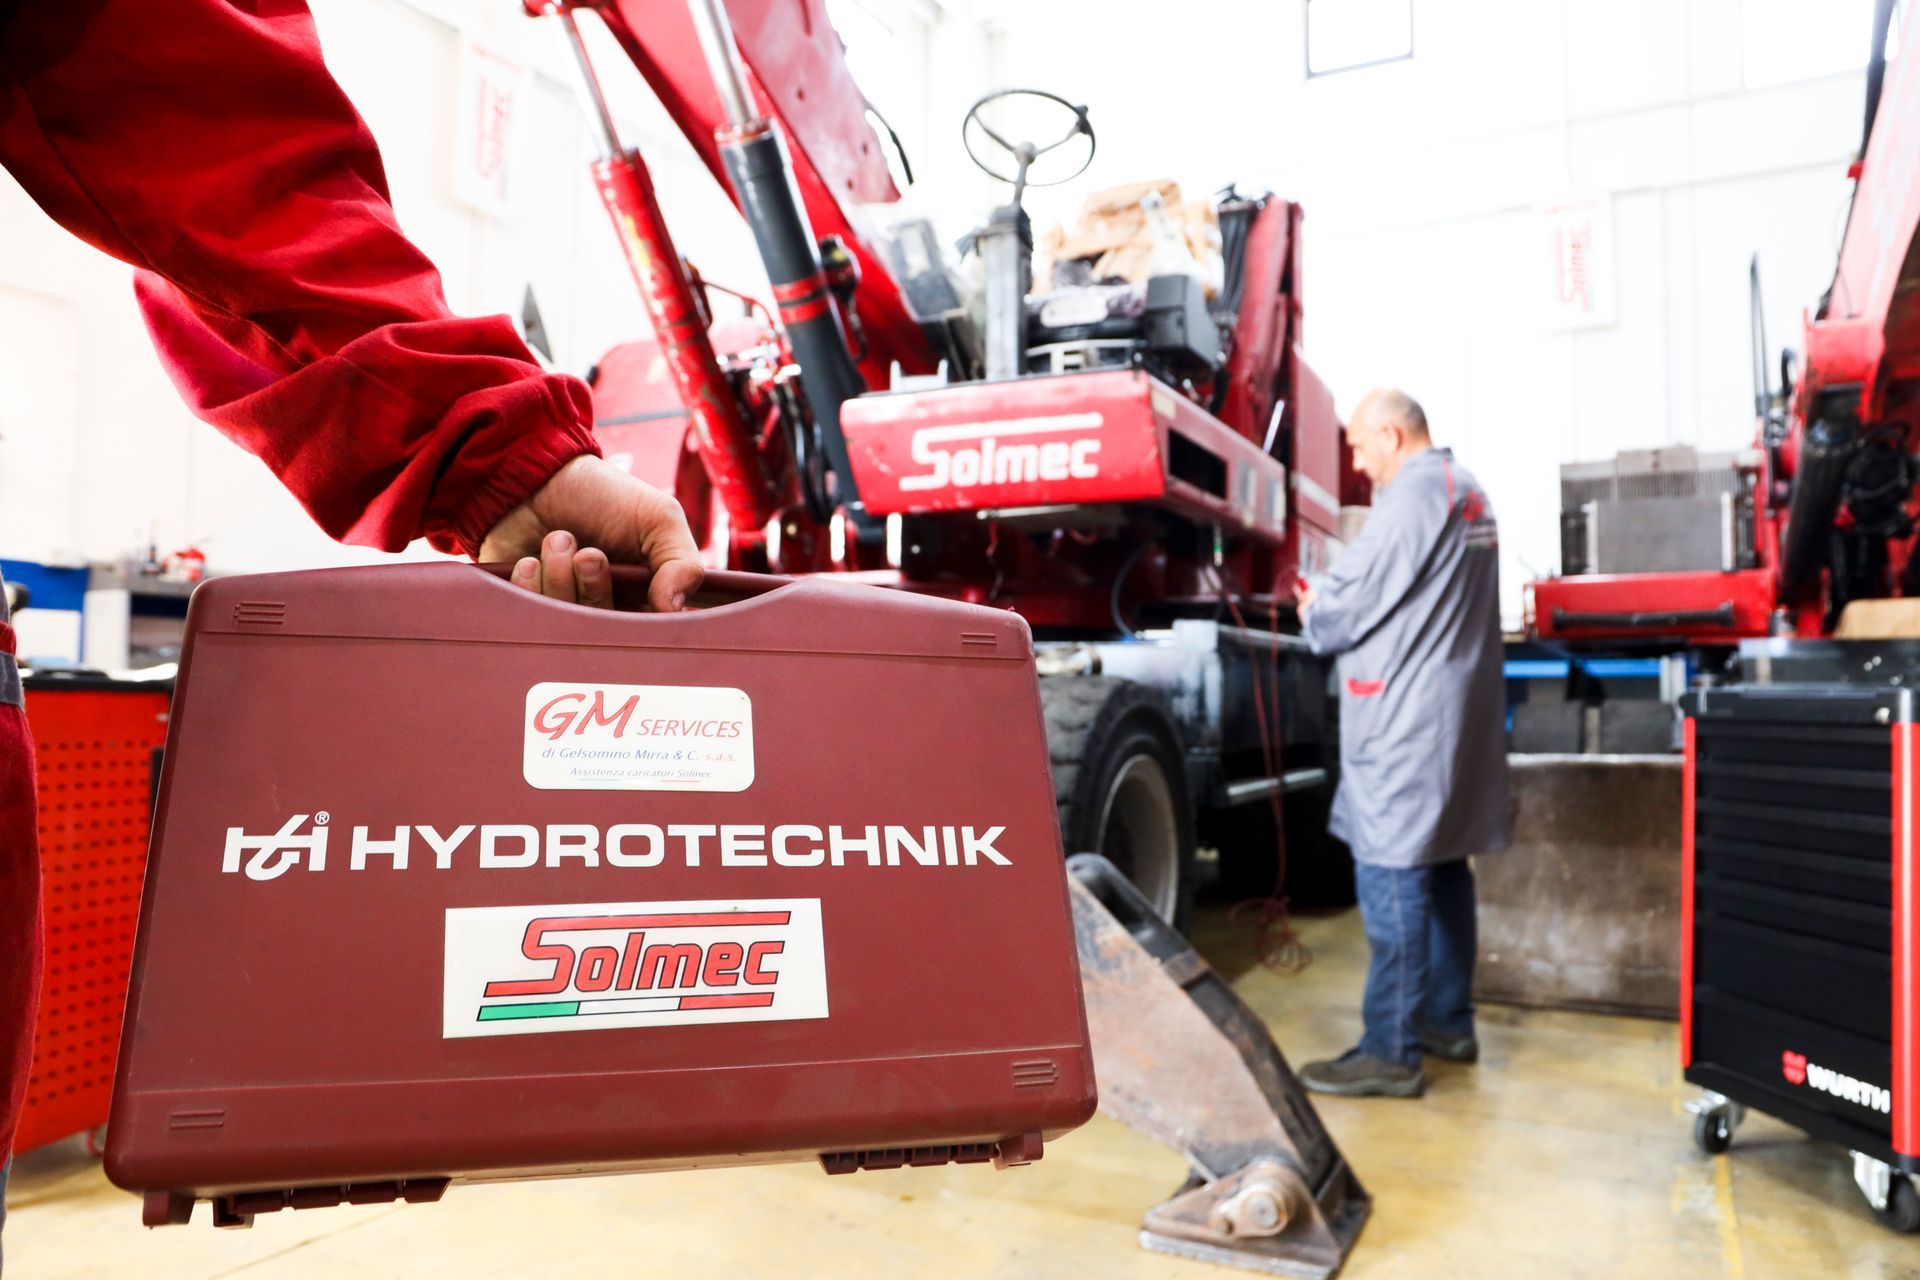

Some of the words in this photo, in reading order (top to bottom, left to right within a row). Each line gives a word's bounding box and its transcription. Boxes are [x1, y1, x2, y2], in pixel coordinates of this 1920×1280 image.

[899, 411, 1103, 491] Solmec
[533, 690, 641, 740] GM
[636, 718, 743, 738] SERVICES
[542, 747, 555, 758] di
[559, 748, 631, 759] Gelsomino
[634, 749, 669, 761] Mirra
[673, 750, 683, 760] &
[687, 750, 700, 761] C.
[704, 753, 737, 762] s.a.s.
[569, 767, 624, 777] Assistenza
[627, 768, 674, 778] caricatori
[677, 769, 712, 778] Solmec
[350, 824, 1013, 870] HYDROTECHNIK
[483, 911, 792, 998] Solmec
